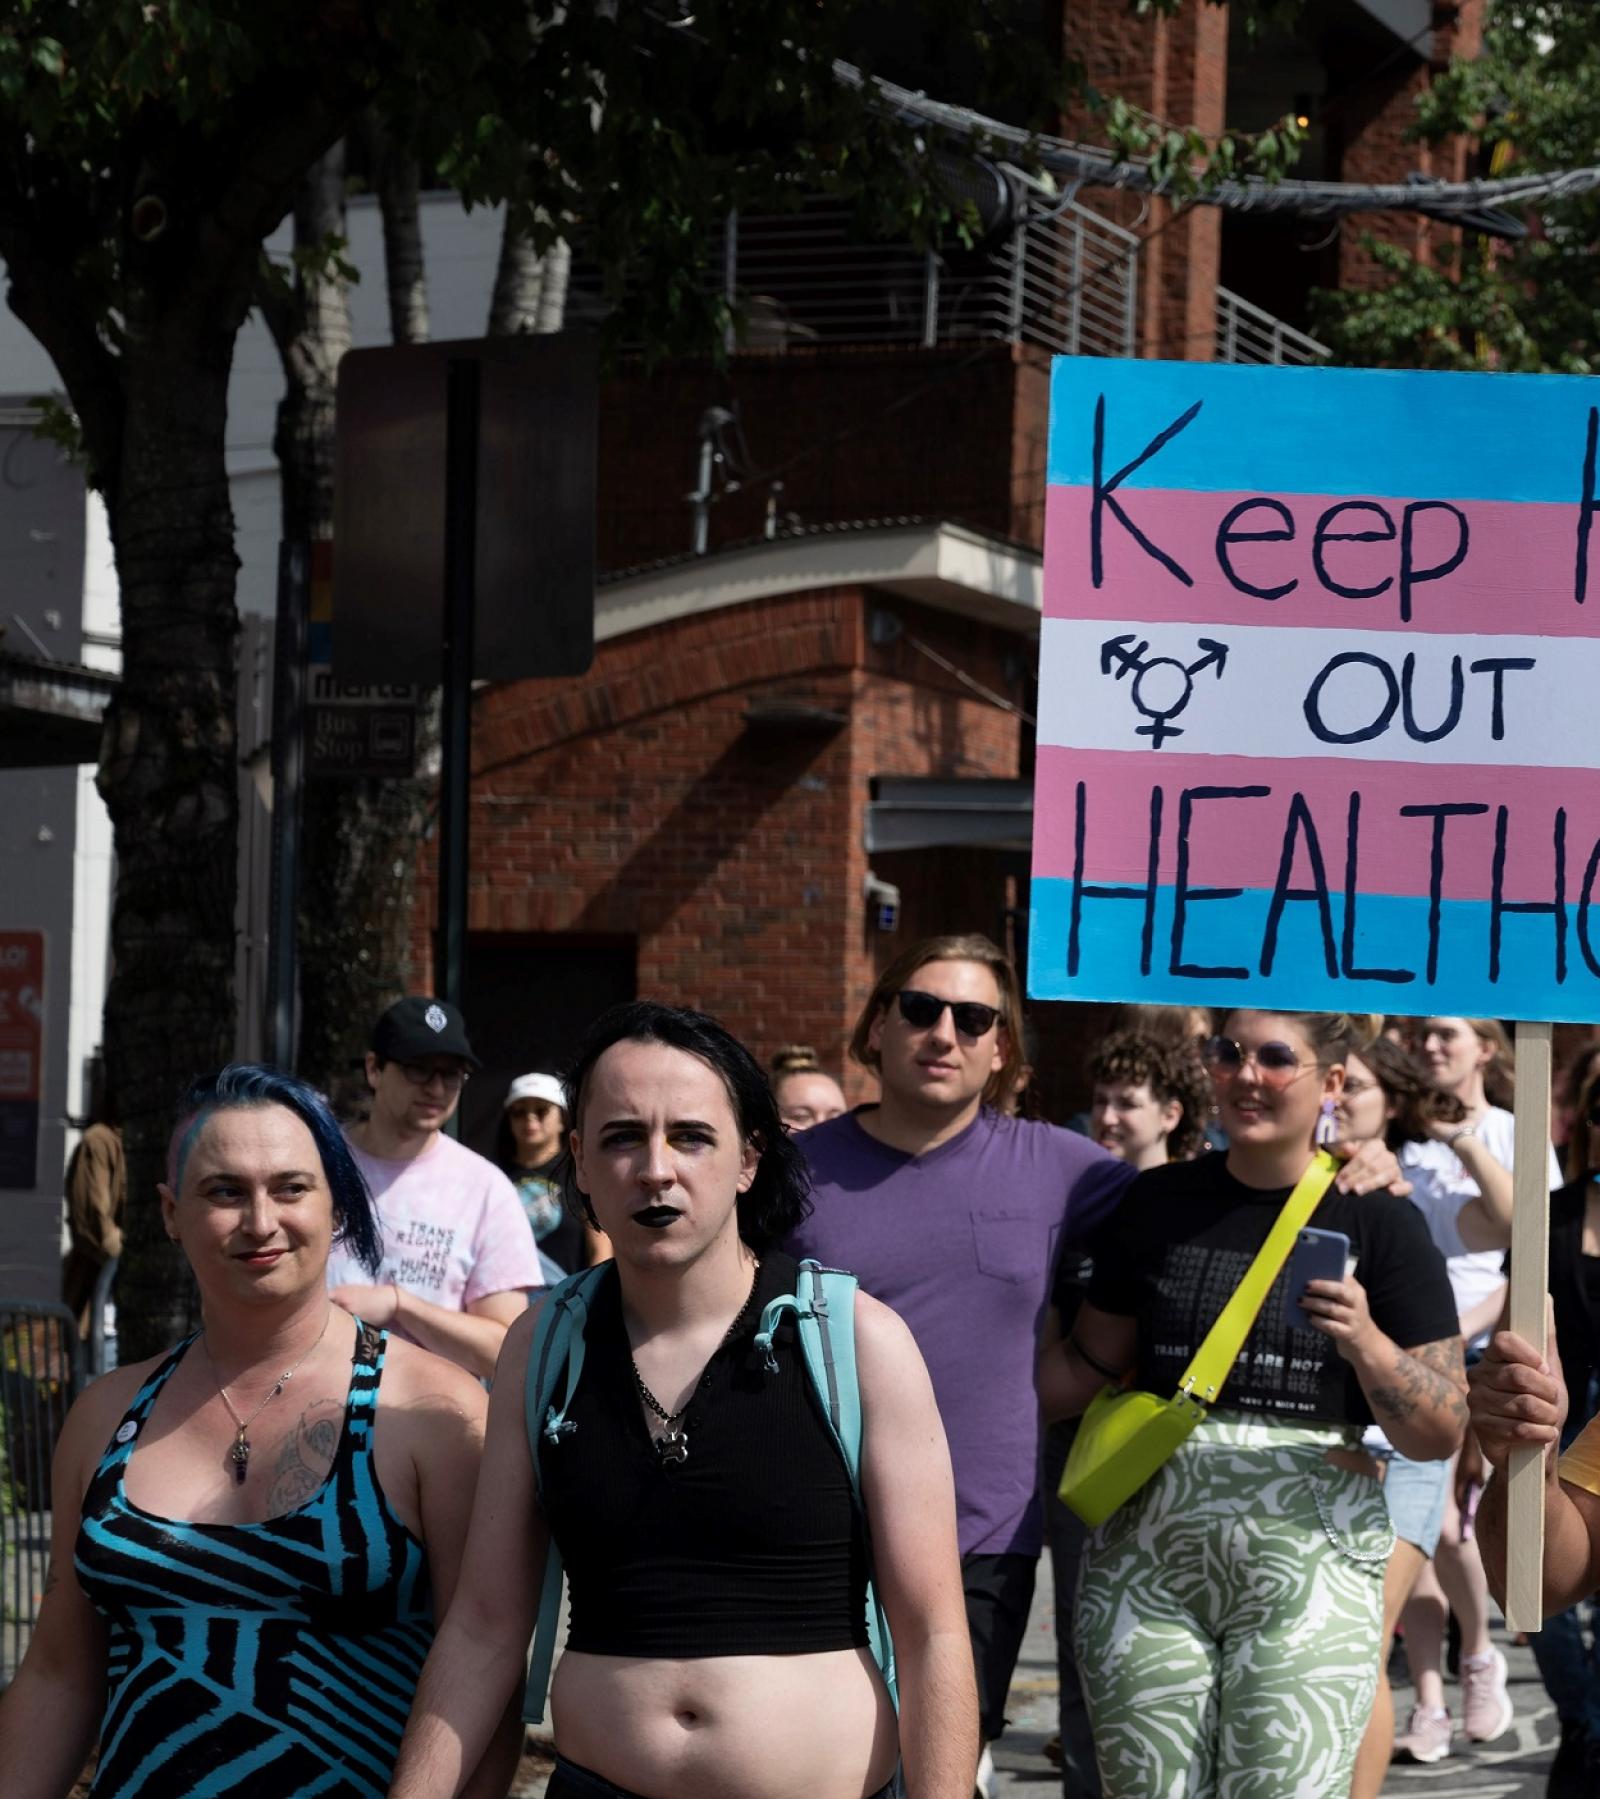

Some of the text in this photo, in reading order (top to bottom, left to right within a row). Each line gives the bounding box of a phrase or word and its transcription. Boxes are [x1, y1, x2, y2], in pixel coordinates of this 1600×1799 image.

[1089, 394, 1470, 621] Keep
[1303, 651, 1536, 744] OUT
[316, 710, 358, 735] Bus
[312, 736, 365, 764] Stop
[1253, 1352, 1285, 1368] ARE
[1289, 1358, 1324, 1373] NOT
